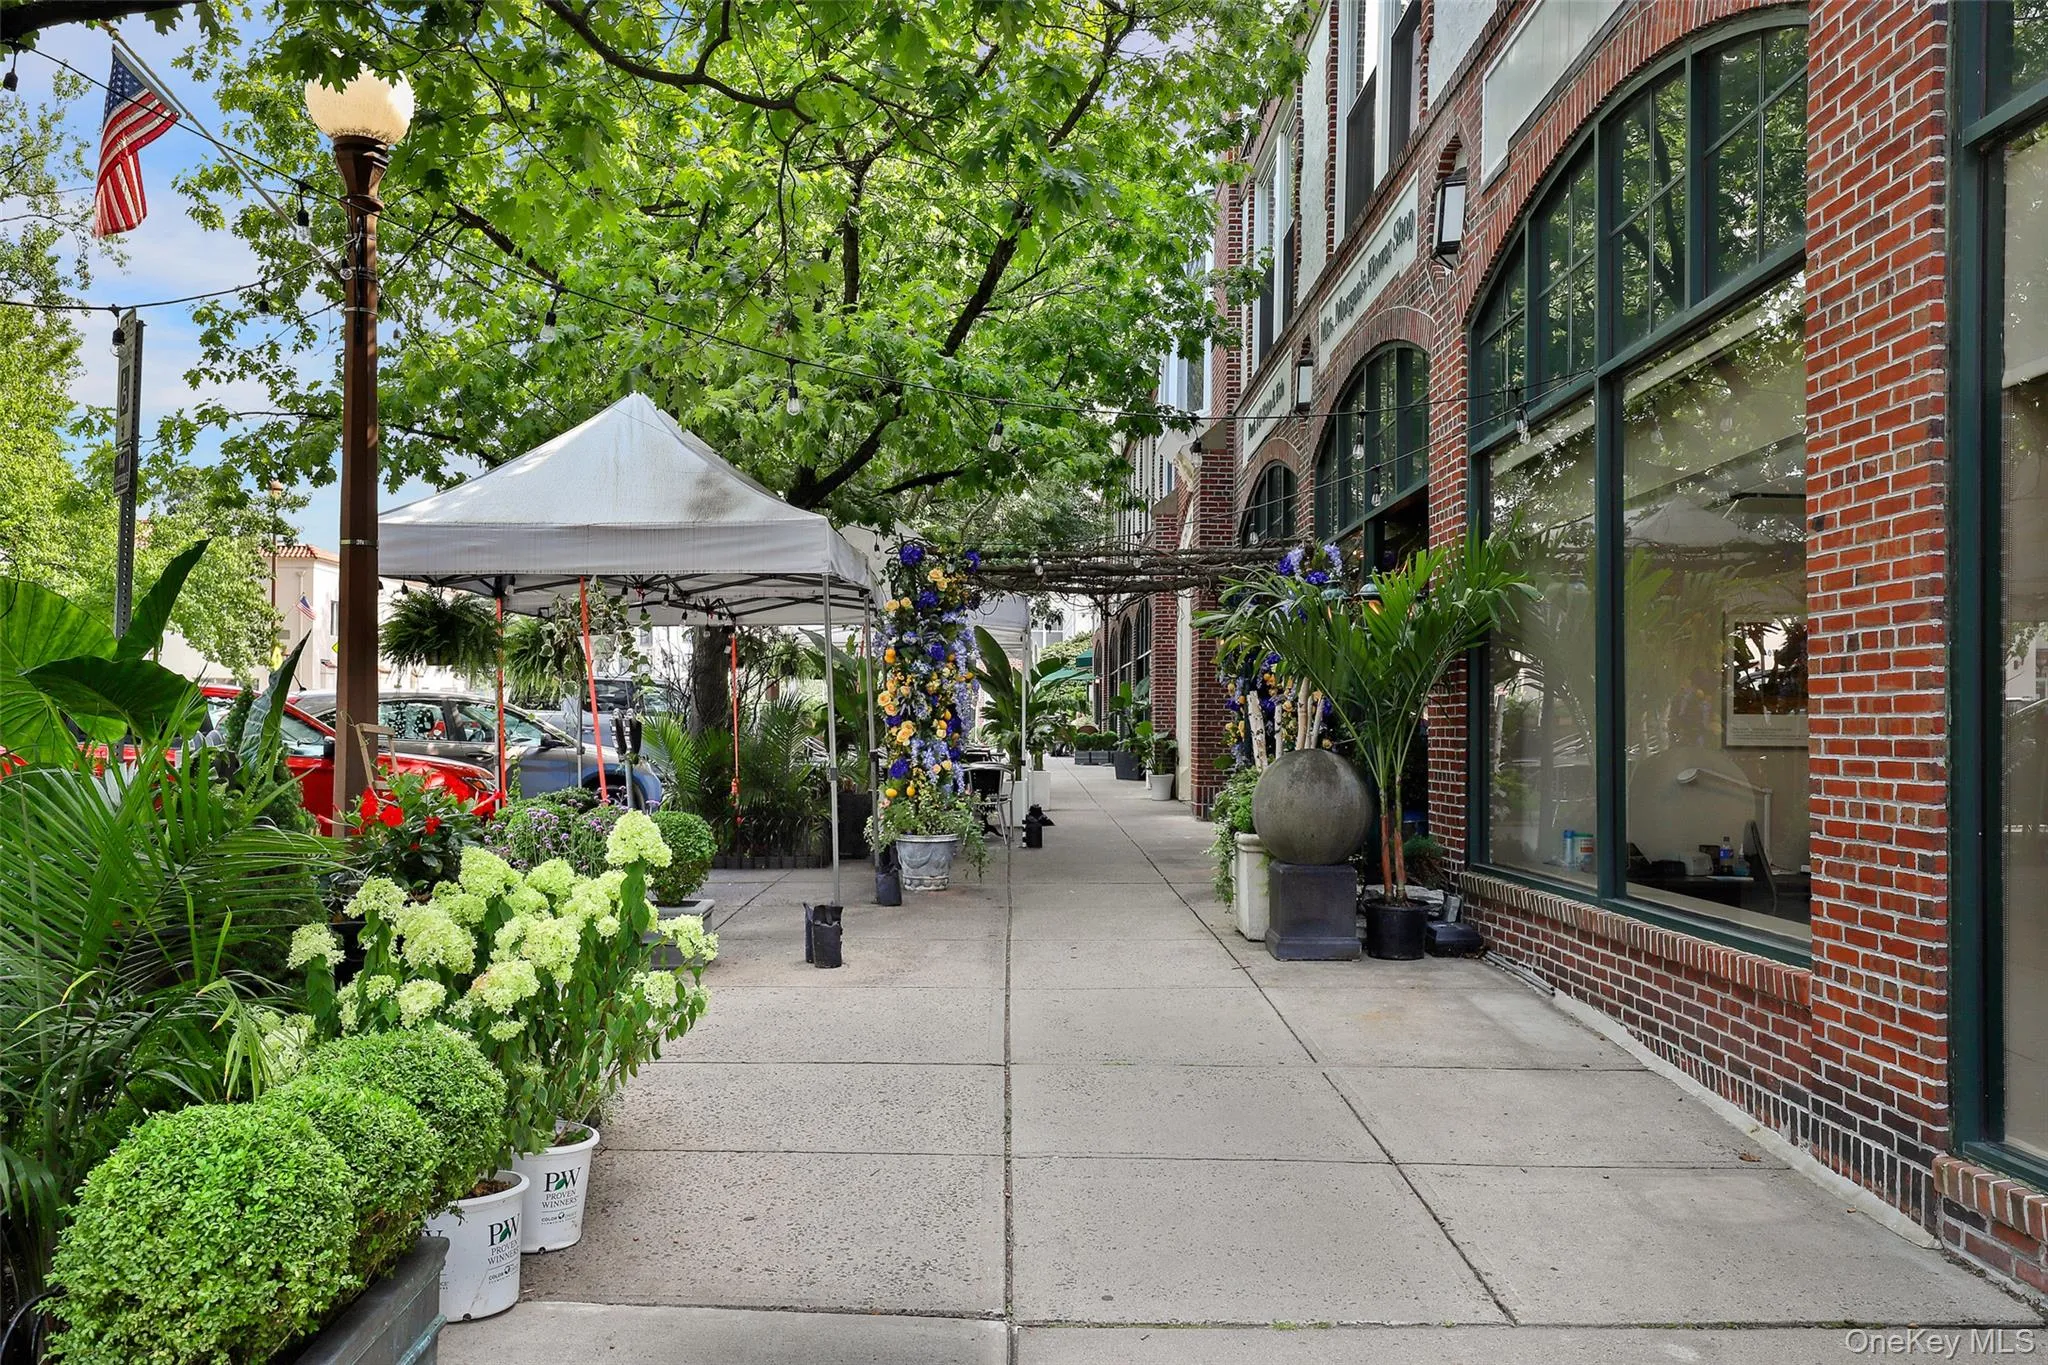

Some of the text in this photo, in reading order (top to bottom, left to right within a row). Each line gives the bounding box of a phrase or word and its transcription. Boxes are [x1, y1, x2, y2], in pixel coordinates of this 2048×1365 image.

[1334, 269, 1368, 327] Morgan's
[1367, 238, 1393, 287] Flower
[1392, 208, 1415, 253] Shop
[541, 1195, 578, 1208] WINNERS
[546, 1188, 577, 1200] PROVEN
[491, 1239, 519, 1256] PROVEN
